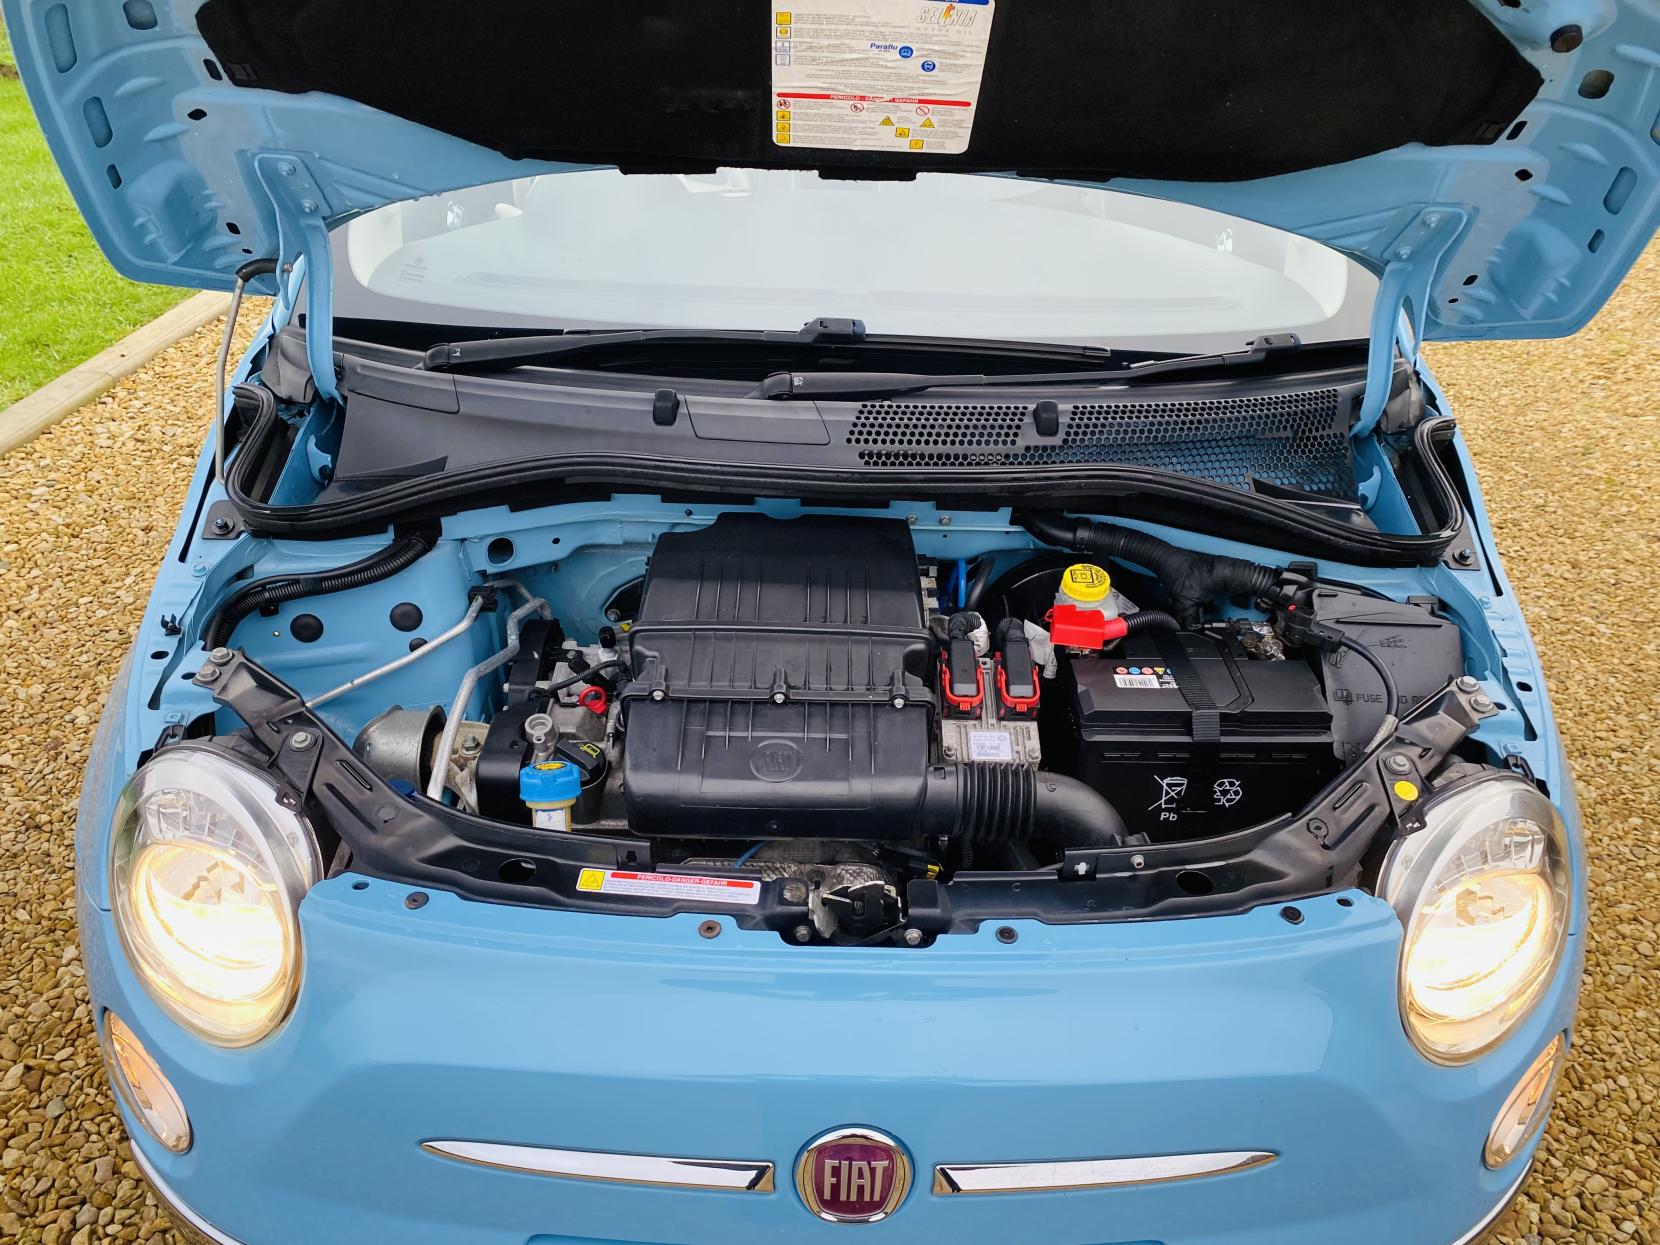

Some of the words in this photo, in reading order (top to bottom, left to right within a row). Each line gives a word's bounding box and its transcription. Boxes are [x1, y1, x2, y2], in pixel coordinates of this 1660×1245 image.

[1356, 693, 1384, 704] FUSE
[1160, 811, 1178, 821] Pb
[823, 1159, 889, 1202] FIAT
